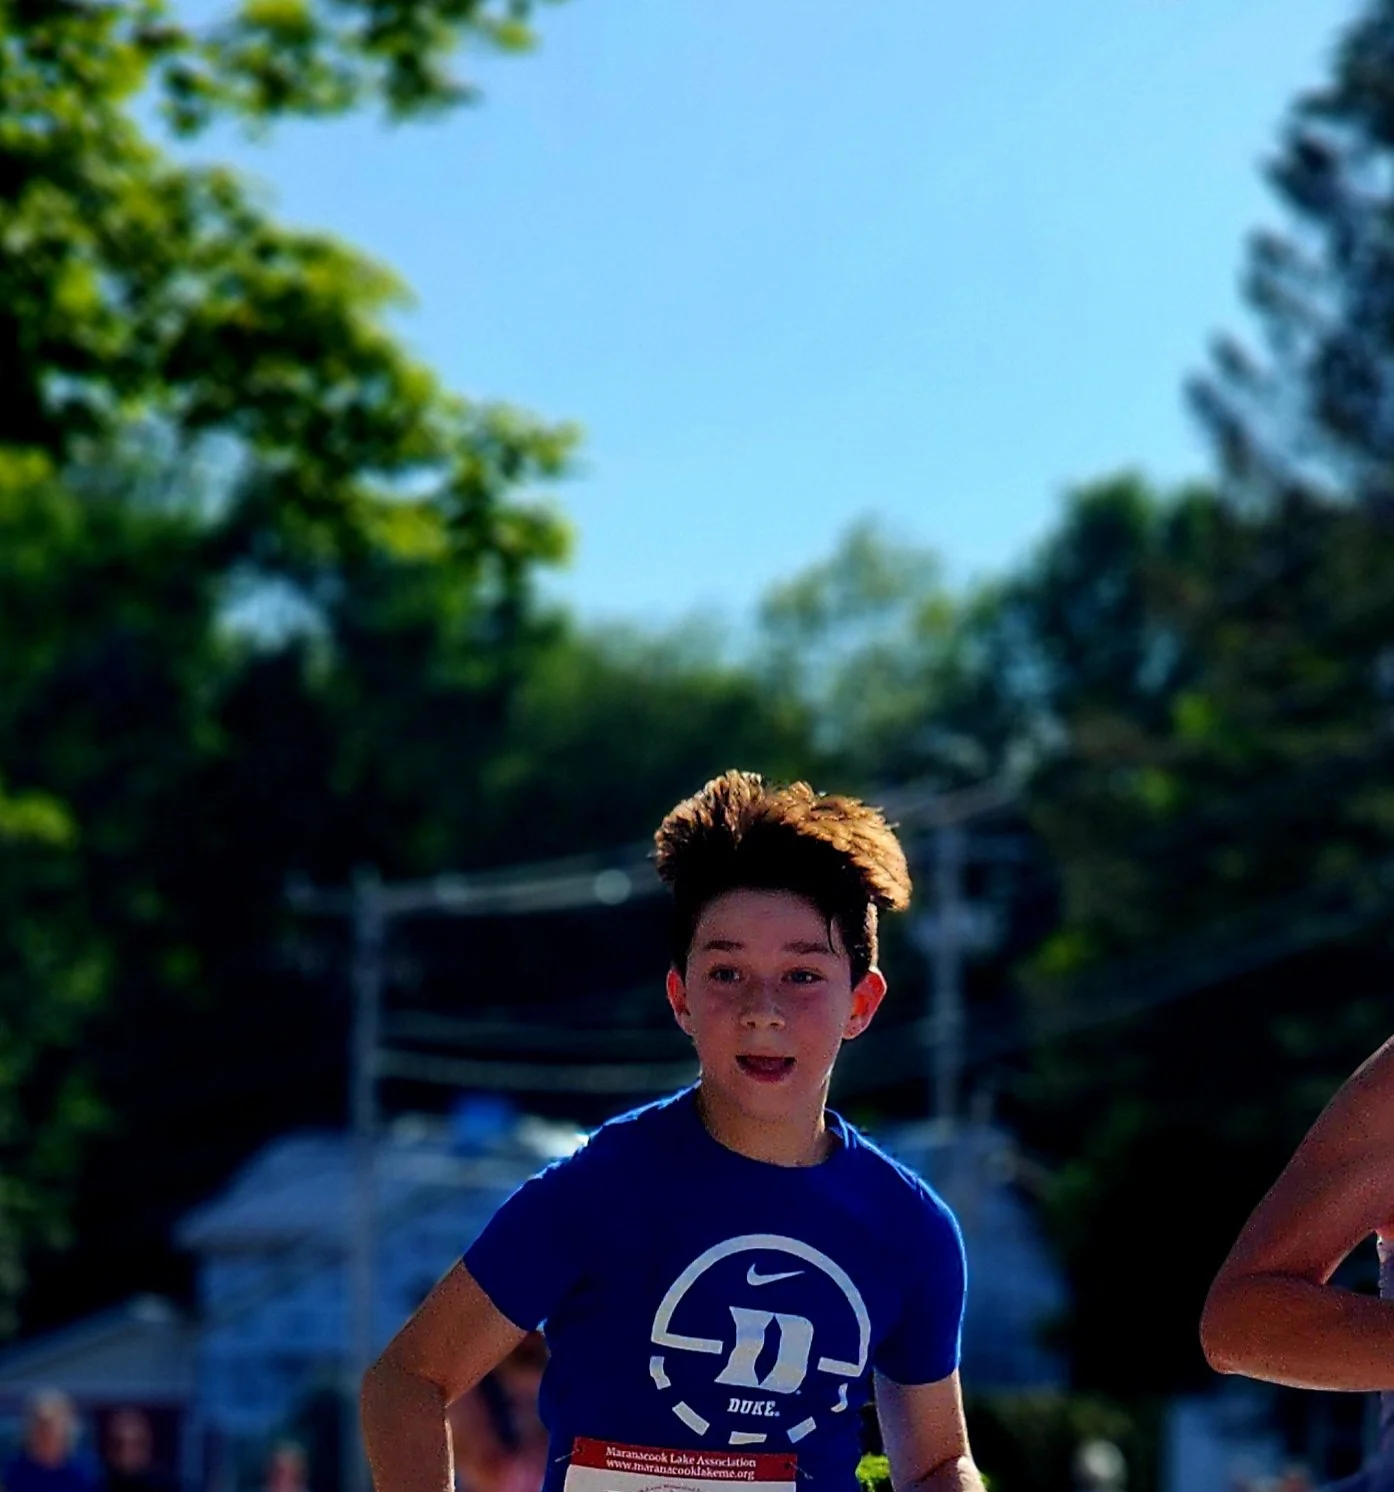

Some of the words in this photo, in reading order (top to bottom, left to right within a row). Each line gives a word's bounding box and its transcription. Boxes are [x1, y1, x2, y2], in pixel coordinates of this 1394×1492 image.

[605, 1446, 668, 1463] Maranacook
[670, 1453, 695, 1465] Lake
[696, 1456, 756, 1467] Association
[606, 1459, 755, 1480] www.maranacooklakeme.org
